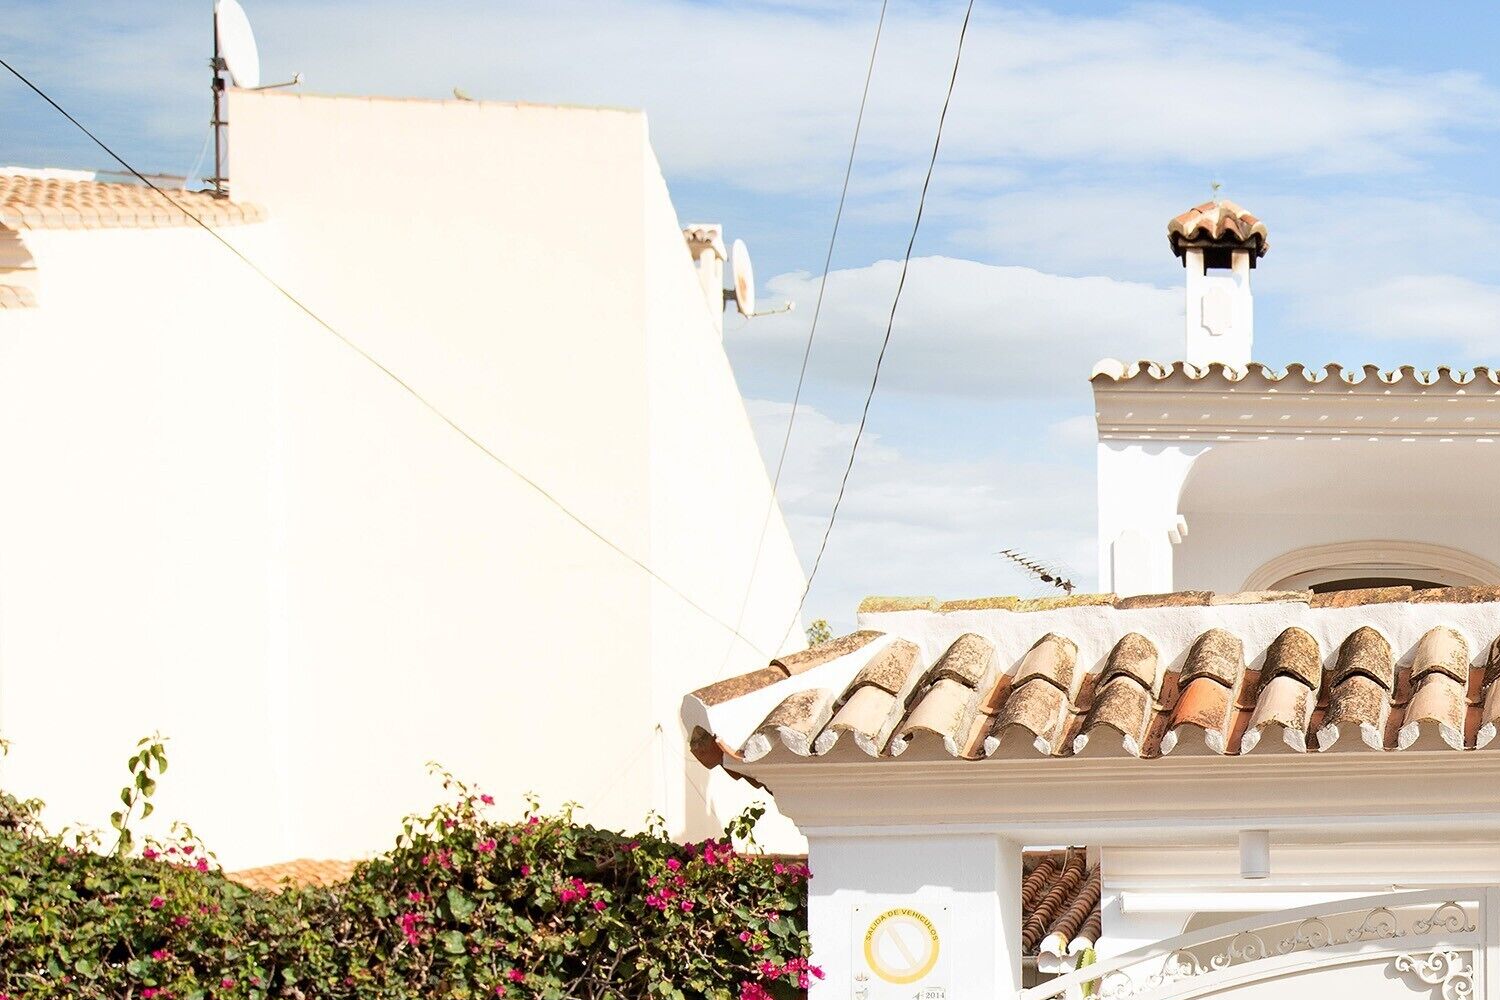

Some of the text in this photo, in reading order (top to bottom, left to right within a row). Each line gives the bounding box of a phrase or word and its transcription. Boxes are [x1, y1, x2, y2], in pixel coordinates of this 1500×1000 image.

[866, 908, 939, 941] SALIDA DE VEHICULOS
